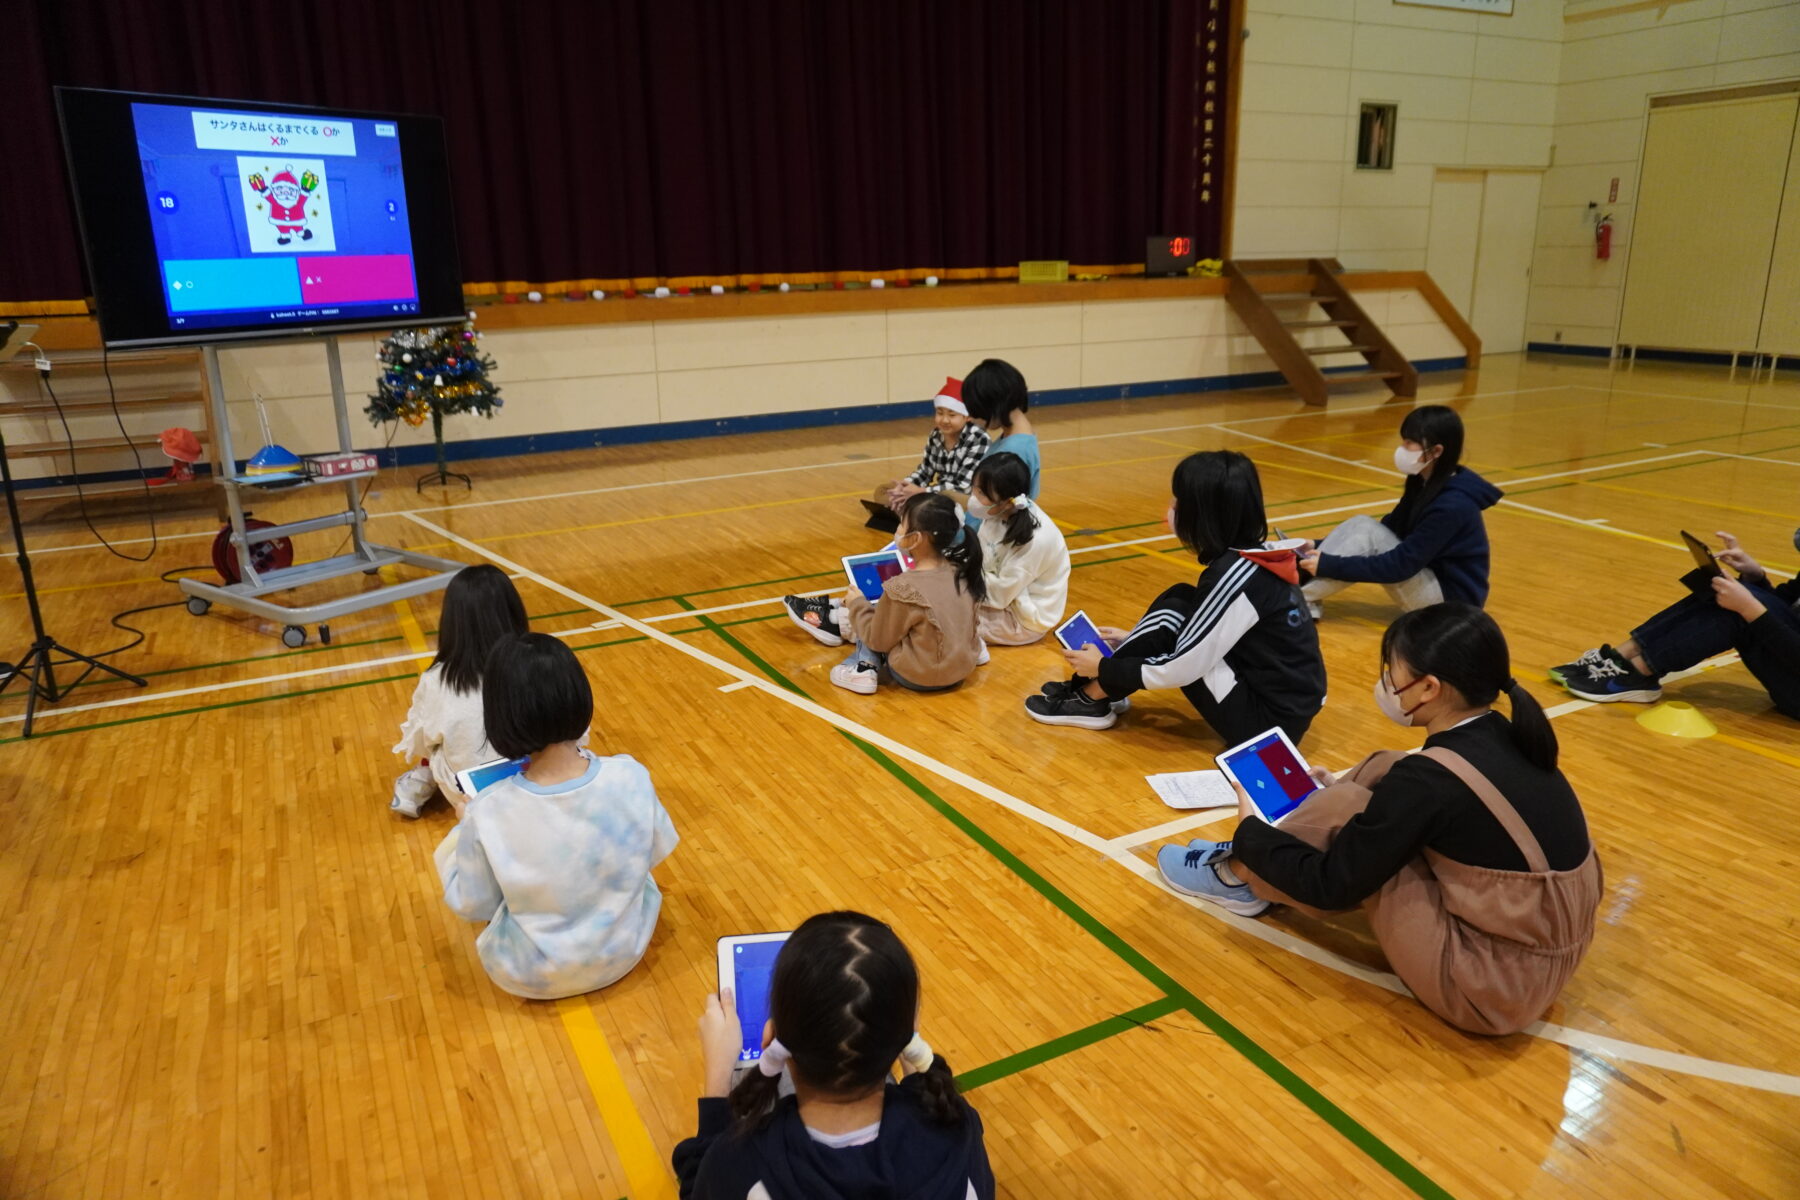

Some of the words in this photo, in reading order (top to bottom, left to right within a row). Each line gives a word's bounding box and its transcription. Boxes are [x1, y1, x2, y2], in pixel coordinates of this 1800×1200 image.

[209, 119, 319, 136] サンタさんはくるまでくる
[159, 197, 175, 209] 18
